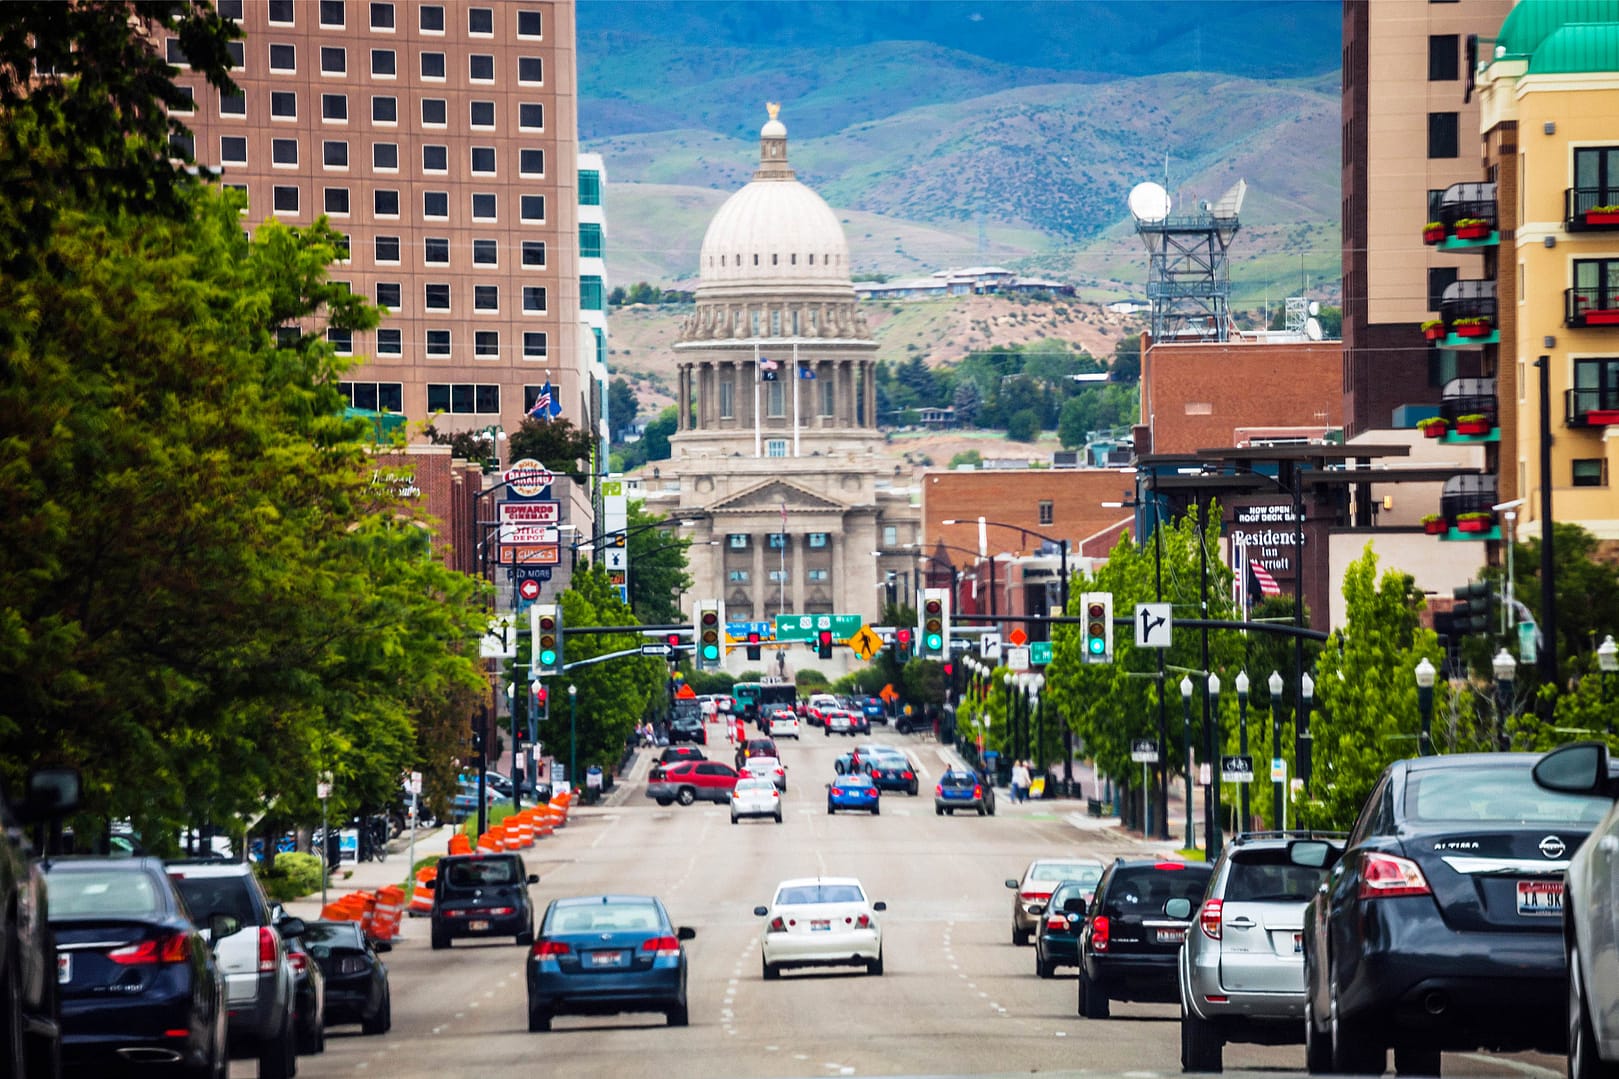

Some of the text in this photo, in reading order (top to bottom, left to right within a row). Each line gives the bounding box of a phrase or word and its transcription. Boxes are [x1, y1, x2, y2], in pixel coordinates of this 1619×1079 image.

[505, 506, 553, 514] EDWARDS
[1249, 505, 1290, 514] NOW OPEN
[1239, 513, 1300, 522] ROOF DECK BA
[1261, 546, 1279, 557] Inn
